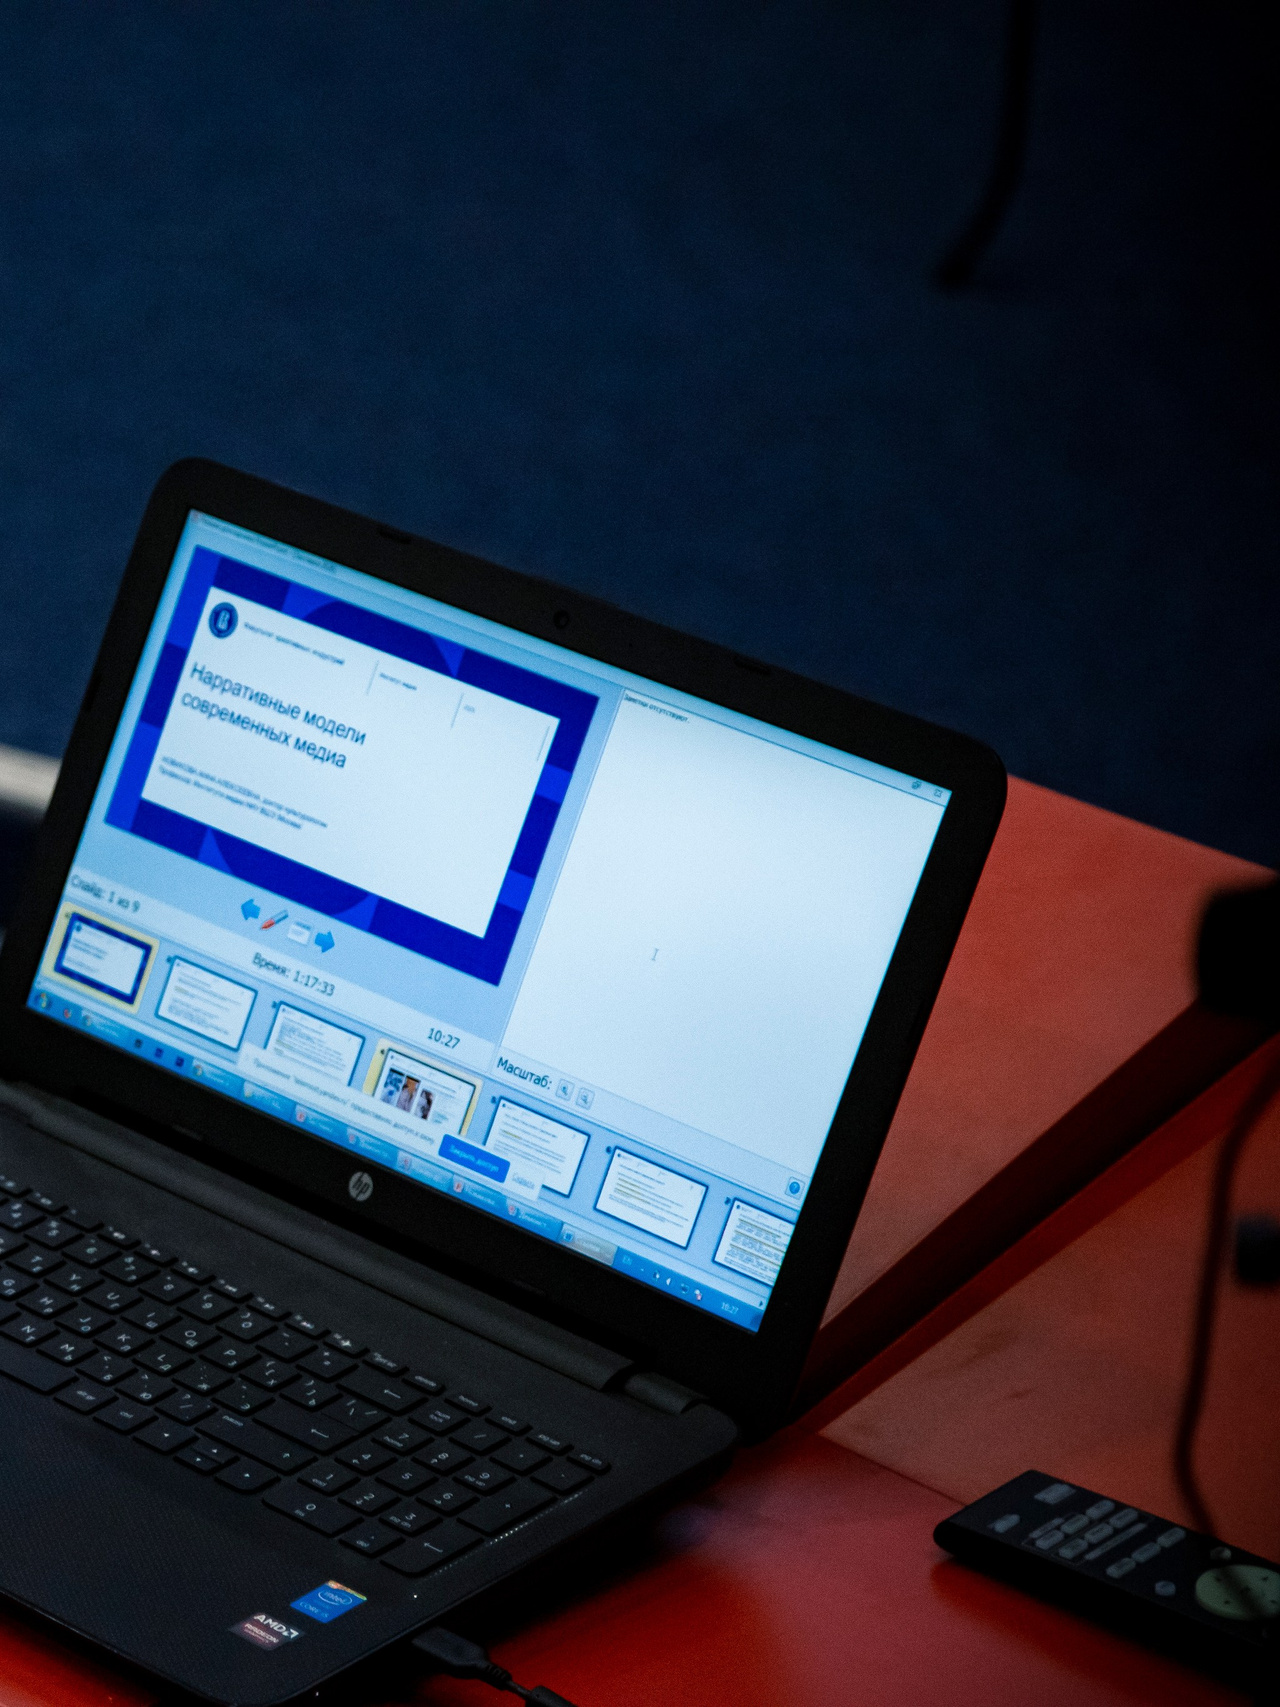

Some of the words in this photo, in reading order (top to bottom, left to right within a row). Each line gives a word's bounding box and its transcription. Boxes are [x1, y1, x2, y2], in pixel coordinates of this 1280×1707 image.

[189, 661, 300, 719] Нарративные
[302, 710, 366, 745] модели
[180, 692, 291, 746] современных
[293, 736, 346, 768] медиа
[70, 874, 102, 899] Слайд:
[132, 900, 140, 912] 9
[252, 952, 287, 976] Время:
[292, 970, 335, 996] 1:17:33
[427, 1027, 460, 1048] 10:27
[496, 1056, 551, 1089] Масштаб:
